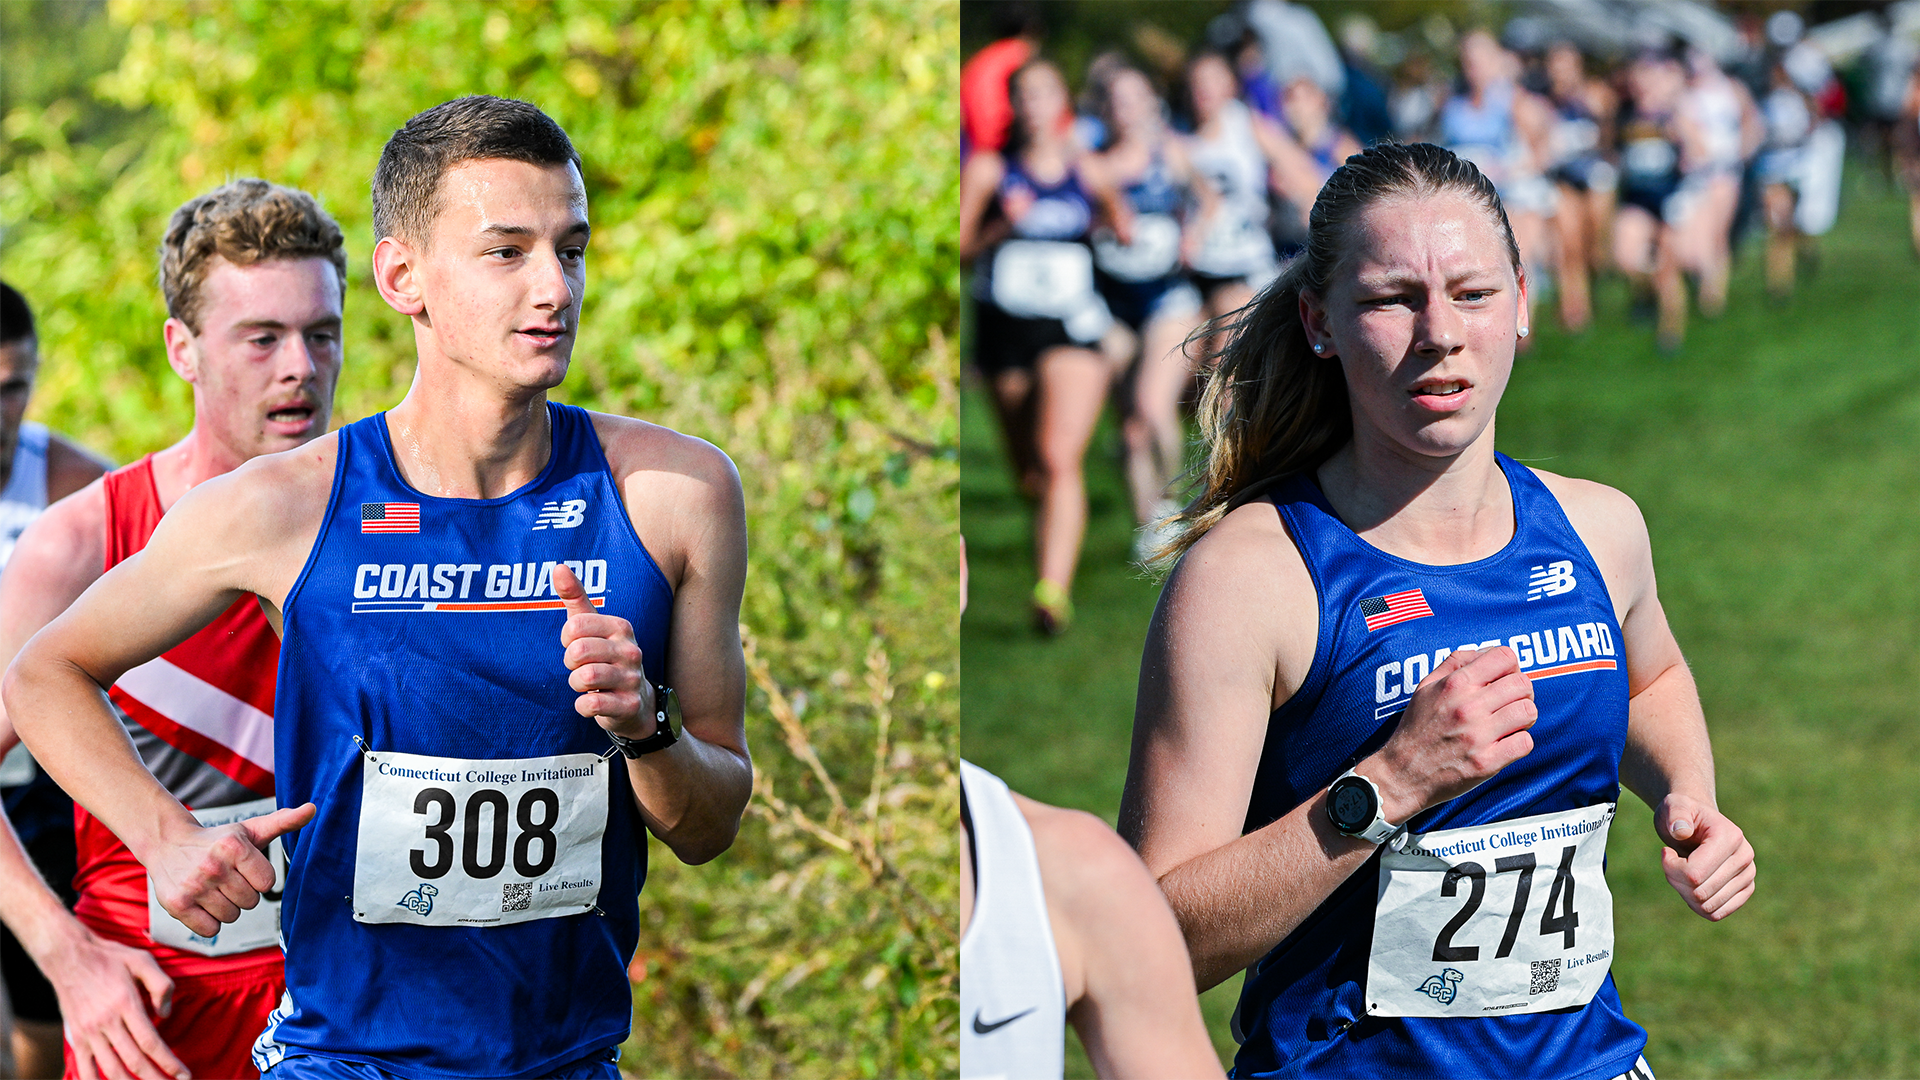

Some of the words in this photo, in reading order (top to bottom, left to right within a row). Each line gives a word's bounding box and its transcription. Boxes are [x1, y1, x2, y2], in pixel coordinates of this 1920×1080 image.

[353, 563, 481, 599] COAST
[1508, 622, 1616, 668] GUARD
[378, 762, 462, 783] Connecticut
[465, 770, 518, 786] College
[520, 763, 595, 783] Invitational
[1338, 792, 1363, 816] 17:46
[409, 787, 560, 880] 308
[1398, 838, 1487, 858] Connecticut
[1489, 832, 1539, 851] College
[1541, 814, 1605, 841] Invitational
[538, 882, 560, 893] Live
[560, 878, 595, 891] Results
[1431, 844, 1580, 962] 274
[1566, 957, 1585, 970] Live
[1585, 949, 1611, 965] Results
